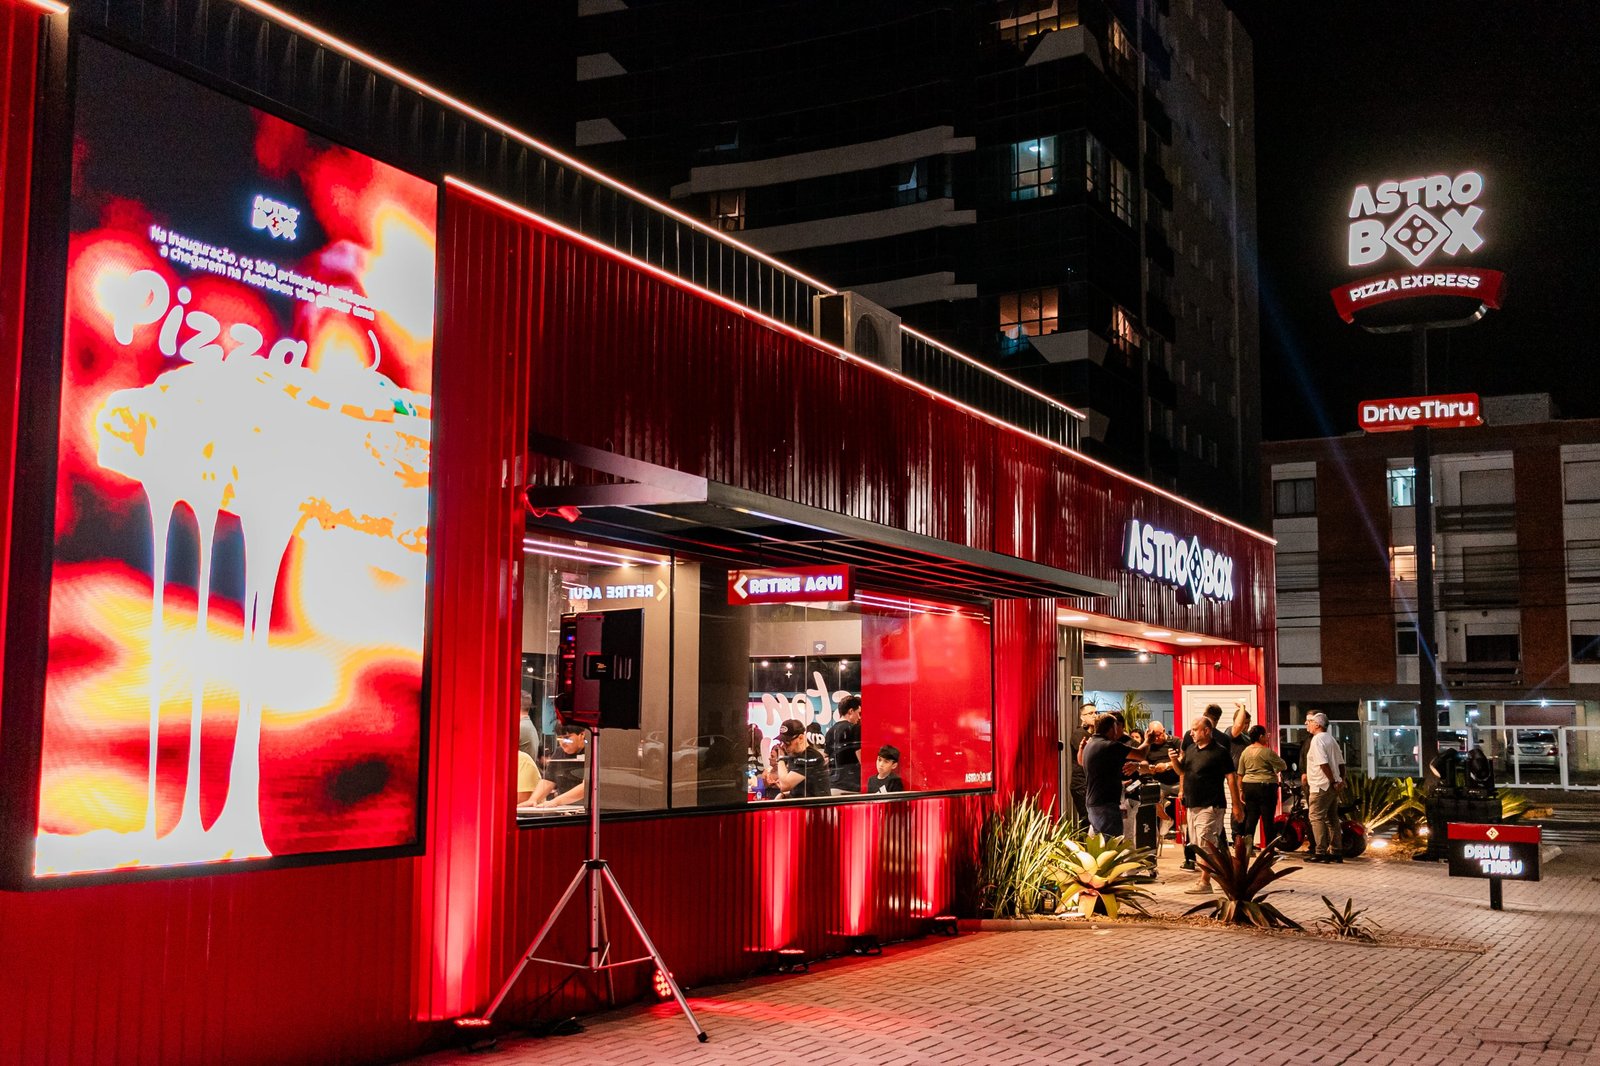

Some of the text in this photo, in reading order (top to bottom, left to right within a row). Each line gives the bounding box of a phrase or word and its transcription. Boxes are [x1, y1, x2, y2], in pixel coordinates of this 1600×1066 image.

[1348, 171, 1483, 218] ASTRO
[1350, 274, 1481, 301] PIZZA EXPRESS
[1127, 519, 1234, 602] ASTRO BOX
[749, 575, 843, 594] RETIRE AQUI
[1463, 844, 1511, 860] DRIVE
[1479, 859, 1523, 876] THRU
